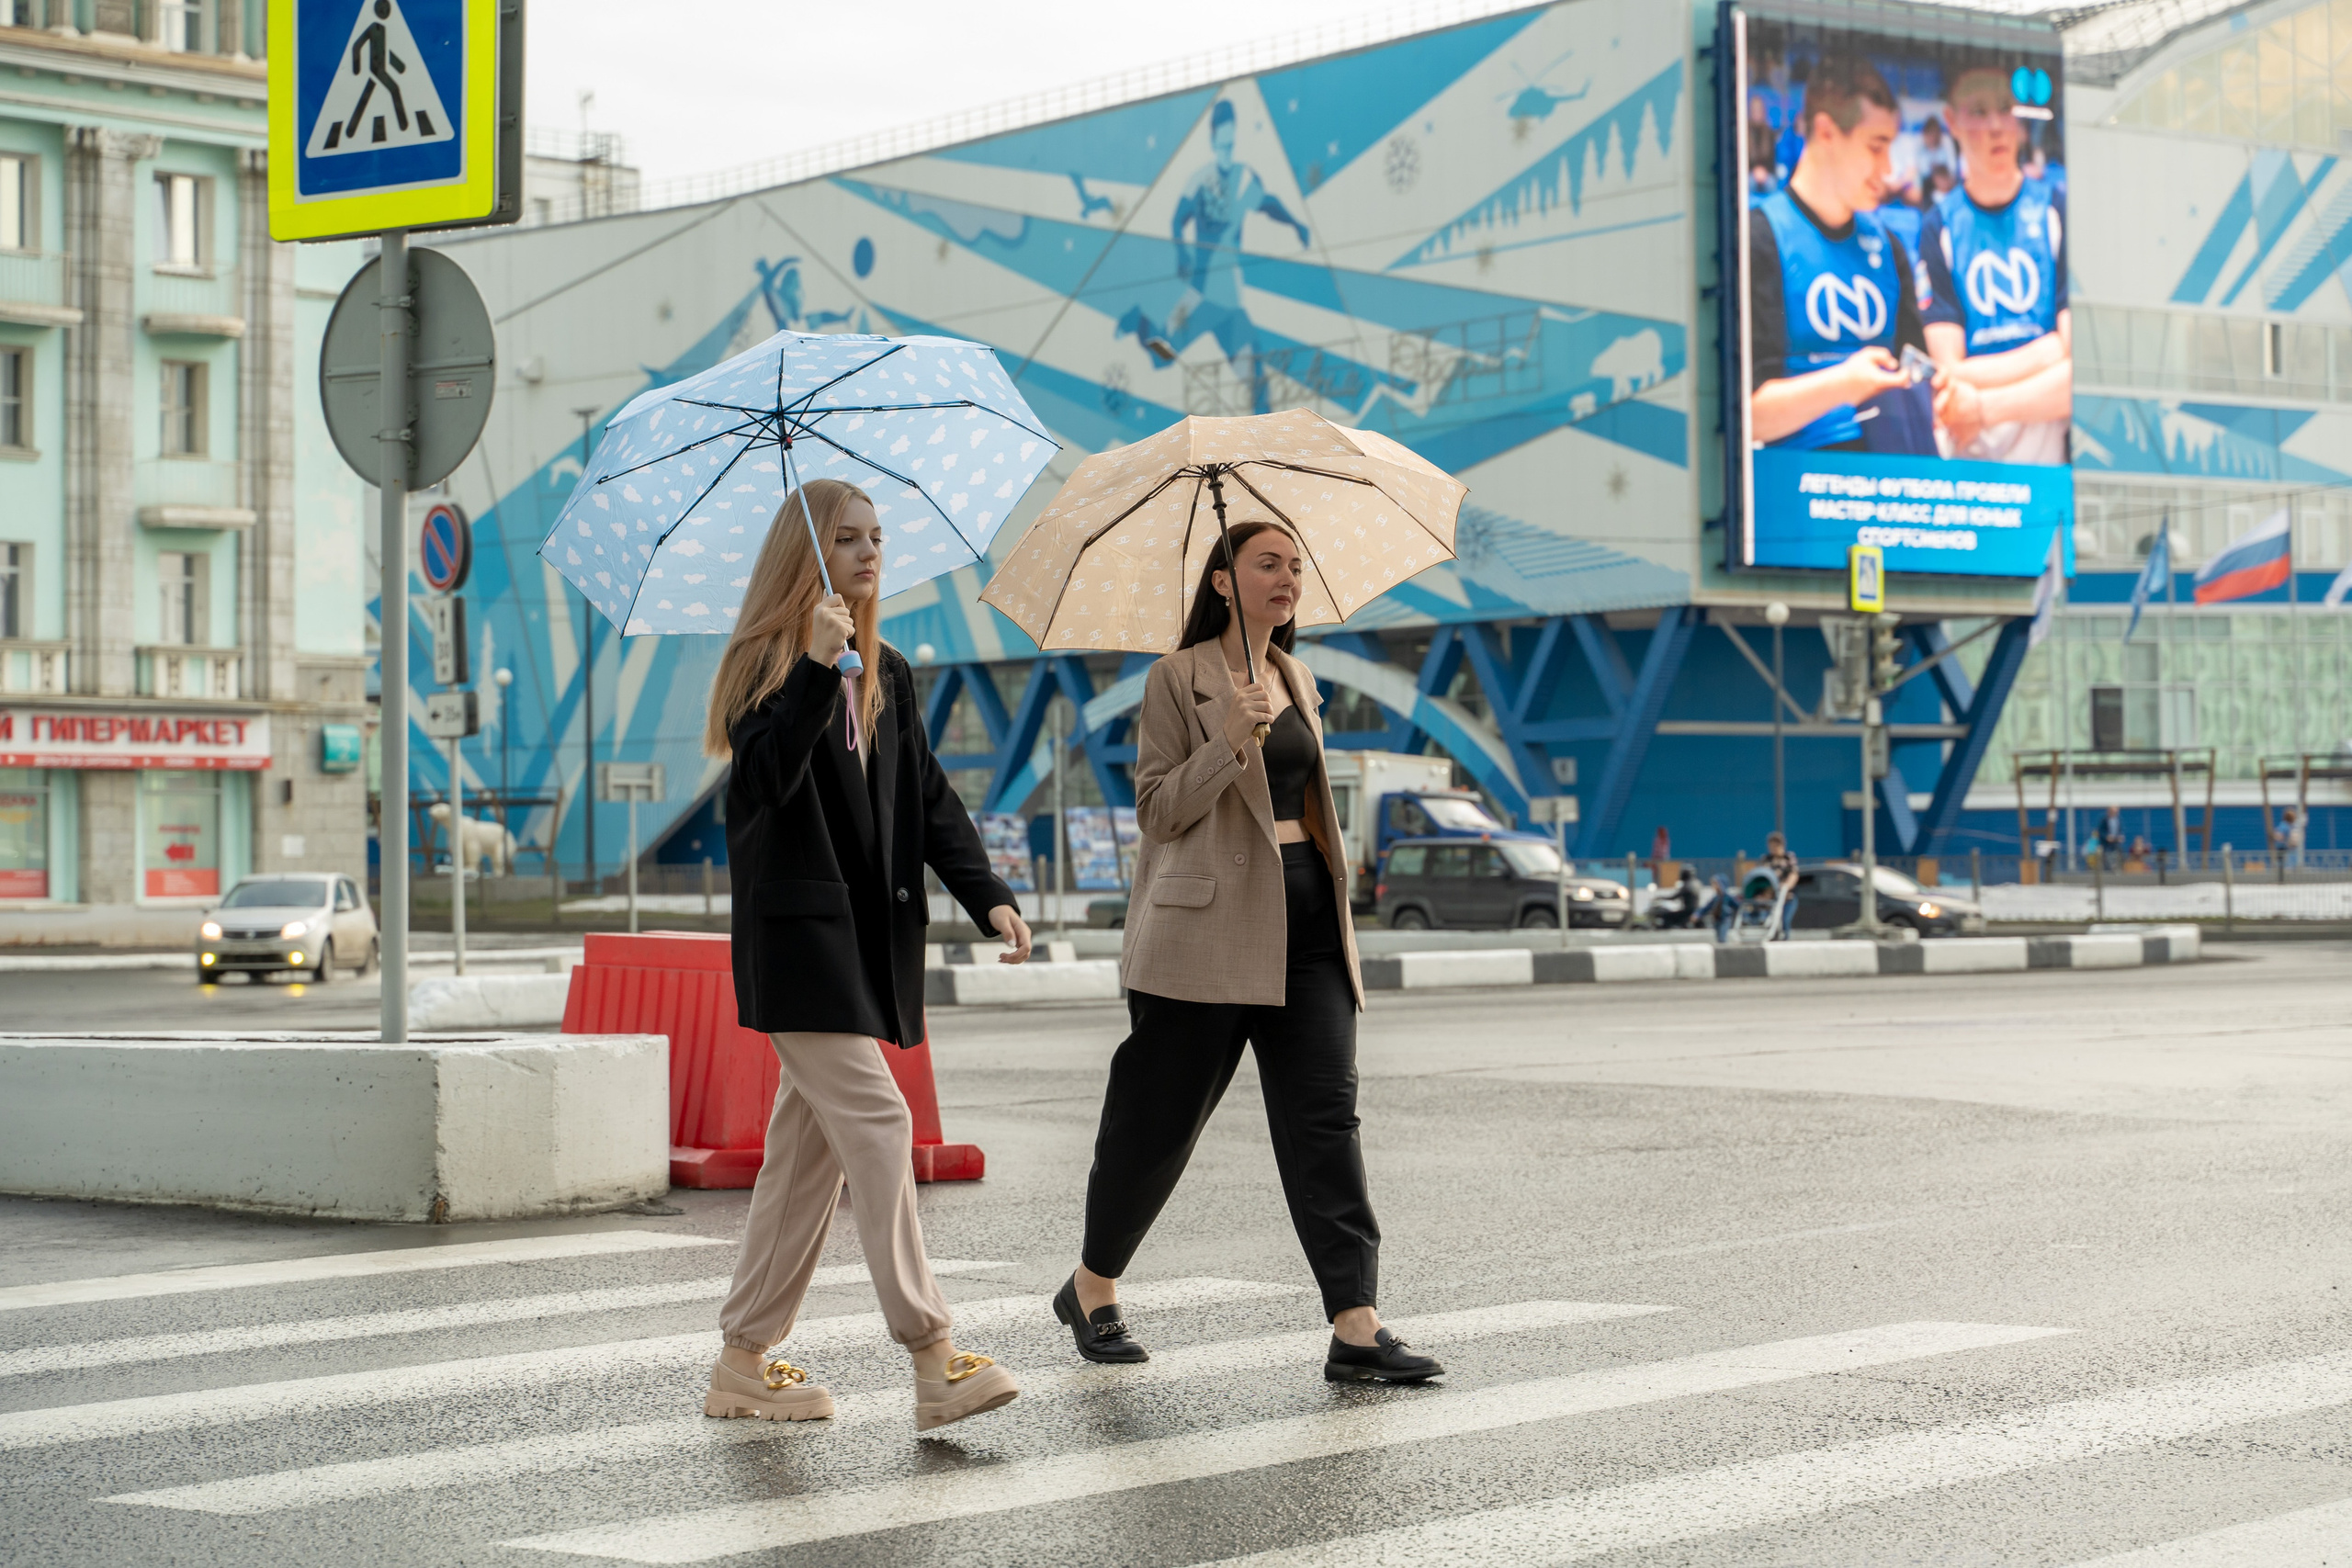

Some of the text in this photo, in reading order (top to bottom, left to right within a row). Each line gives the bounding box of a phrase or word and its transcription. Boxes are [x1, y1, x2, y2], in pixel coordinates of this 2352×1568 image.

[1799, 472, 2031, 504] ЛЕГЕНДЫ ФУТБОЛА ПРОВЕЛИ
[1932, 504, 1968, 526] ДЛЯ
[1969, 506, 2022, 528] ЮНЫХ
[1857, 526, 1977, 550] СПОРТСМЕНОВ
[31, 716, 250, 745] ГИПЕРМАРКЕТ
